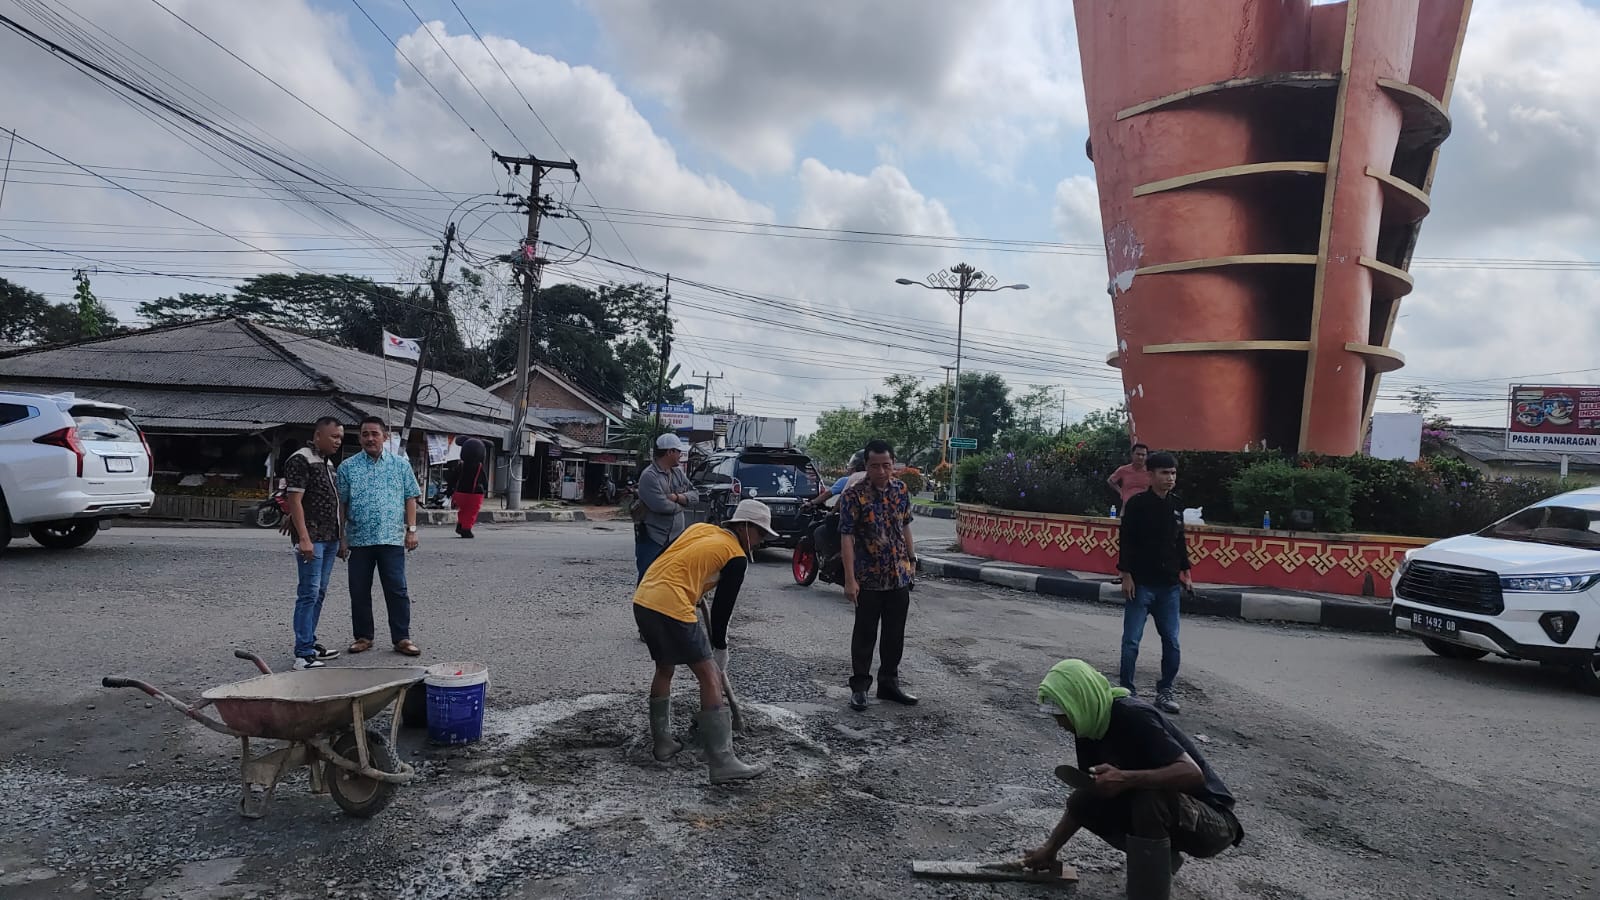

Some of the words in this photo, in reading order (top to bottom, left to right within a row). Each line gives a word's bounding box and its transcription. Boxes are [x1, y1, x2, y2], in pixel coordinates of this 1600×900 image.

[1512, 434, 1540, 444] PASAR
[1543, 436, 1597, 446] PANARAGAN
[1413, 613, 1422, 624] BE
[1425, 616, 1442, 628] 1492
